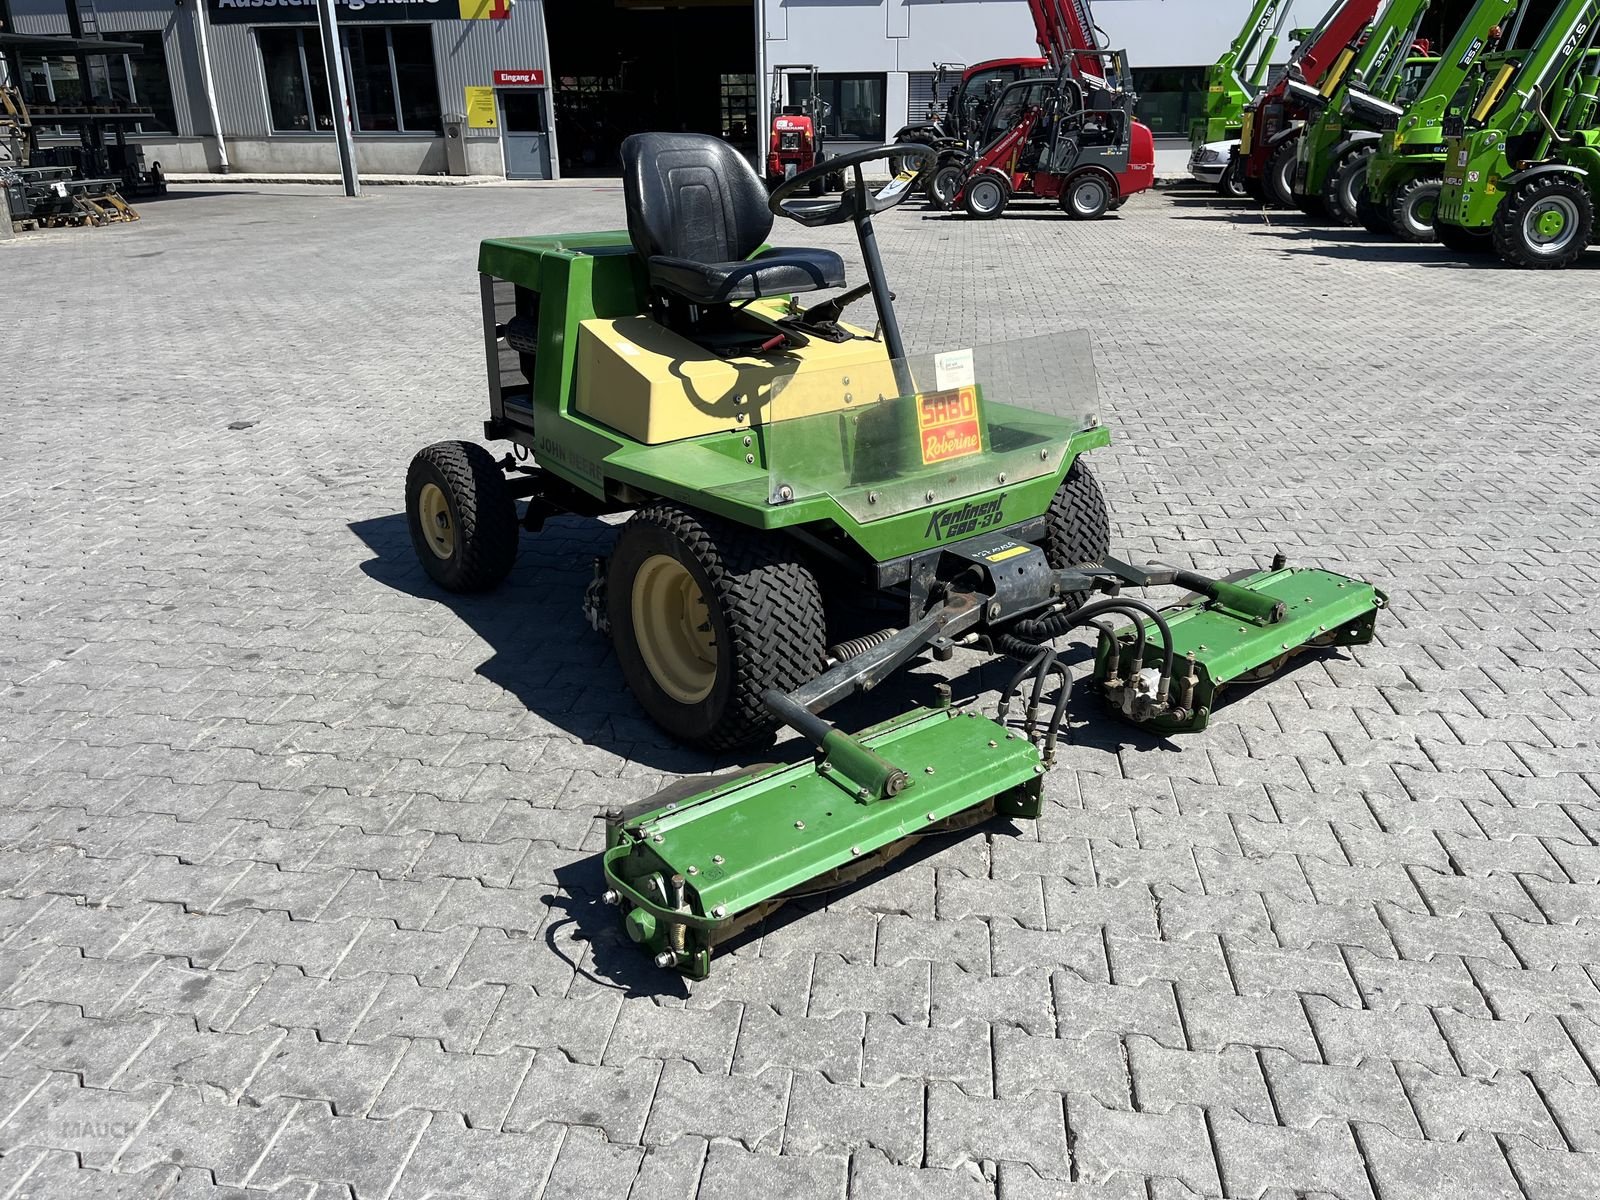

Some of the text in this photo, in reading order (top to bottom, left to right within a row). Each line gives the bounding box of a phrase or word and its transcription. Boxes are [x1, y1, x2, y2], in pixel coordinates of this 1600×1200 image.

[1257, 6, 1275, 33] 40.16
[1562, 22, 1587, 56] 27.6
[1374, 44, 1390, 68] 33.7
[1463, 40, 1482, 65] 25.5
[501, 73, 537, 82] Eingang A
[922, 391, 974, 426] SABO
[540, 436, 567, 461] JOHN
[926, 432, 978, 459] Roberine
